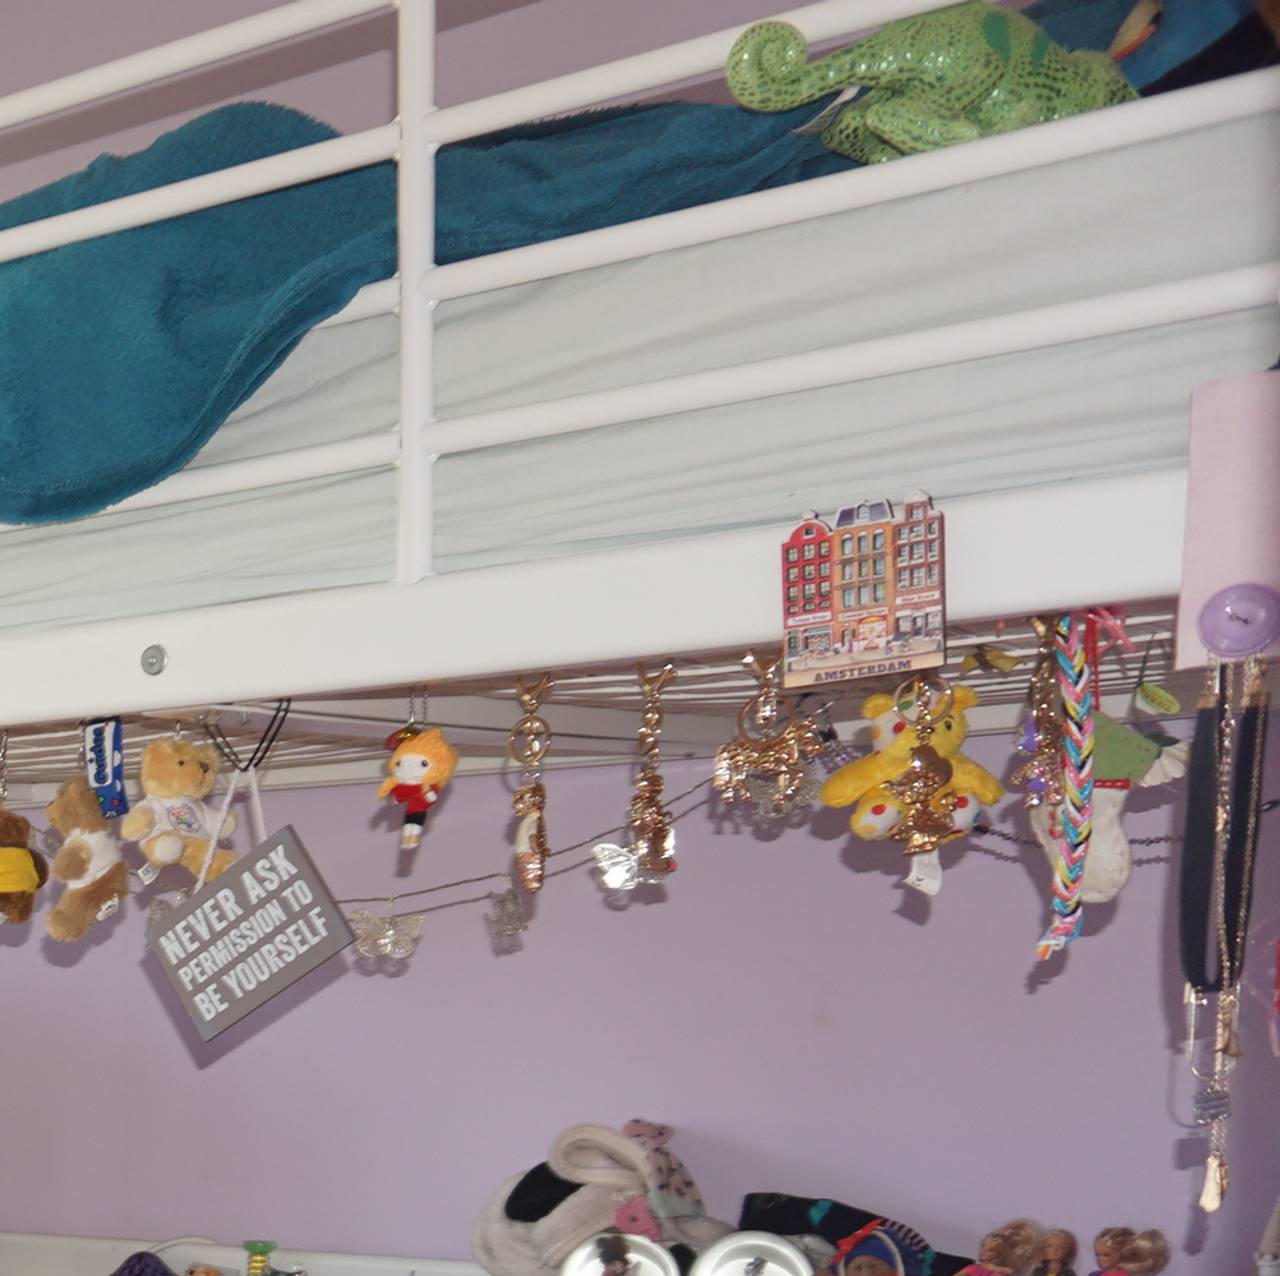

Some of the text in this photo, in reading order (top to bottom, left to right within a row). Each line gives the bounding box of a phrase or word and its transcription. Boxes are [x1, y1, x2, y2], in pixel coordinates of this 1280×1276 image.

[814, 660, 912, 682] AMSTERDAM
[158, 844, 298, 964] NEVER ASK
[178, 880, 313, 991] PERMISSION TO
[193, 906, 329, 1022] BE YOURSELF
